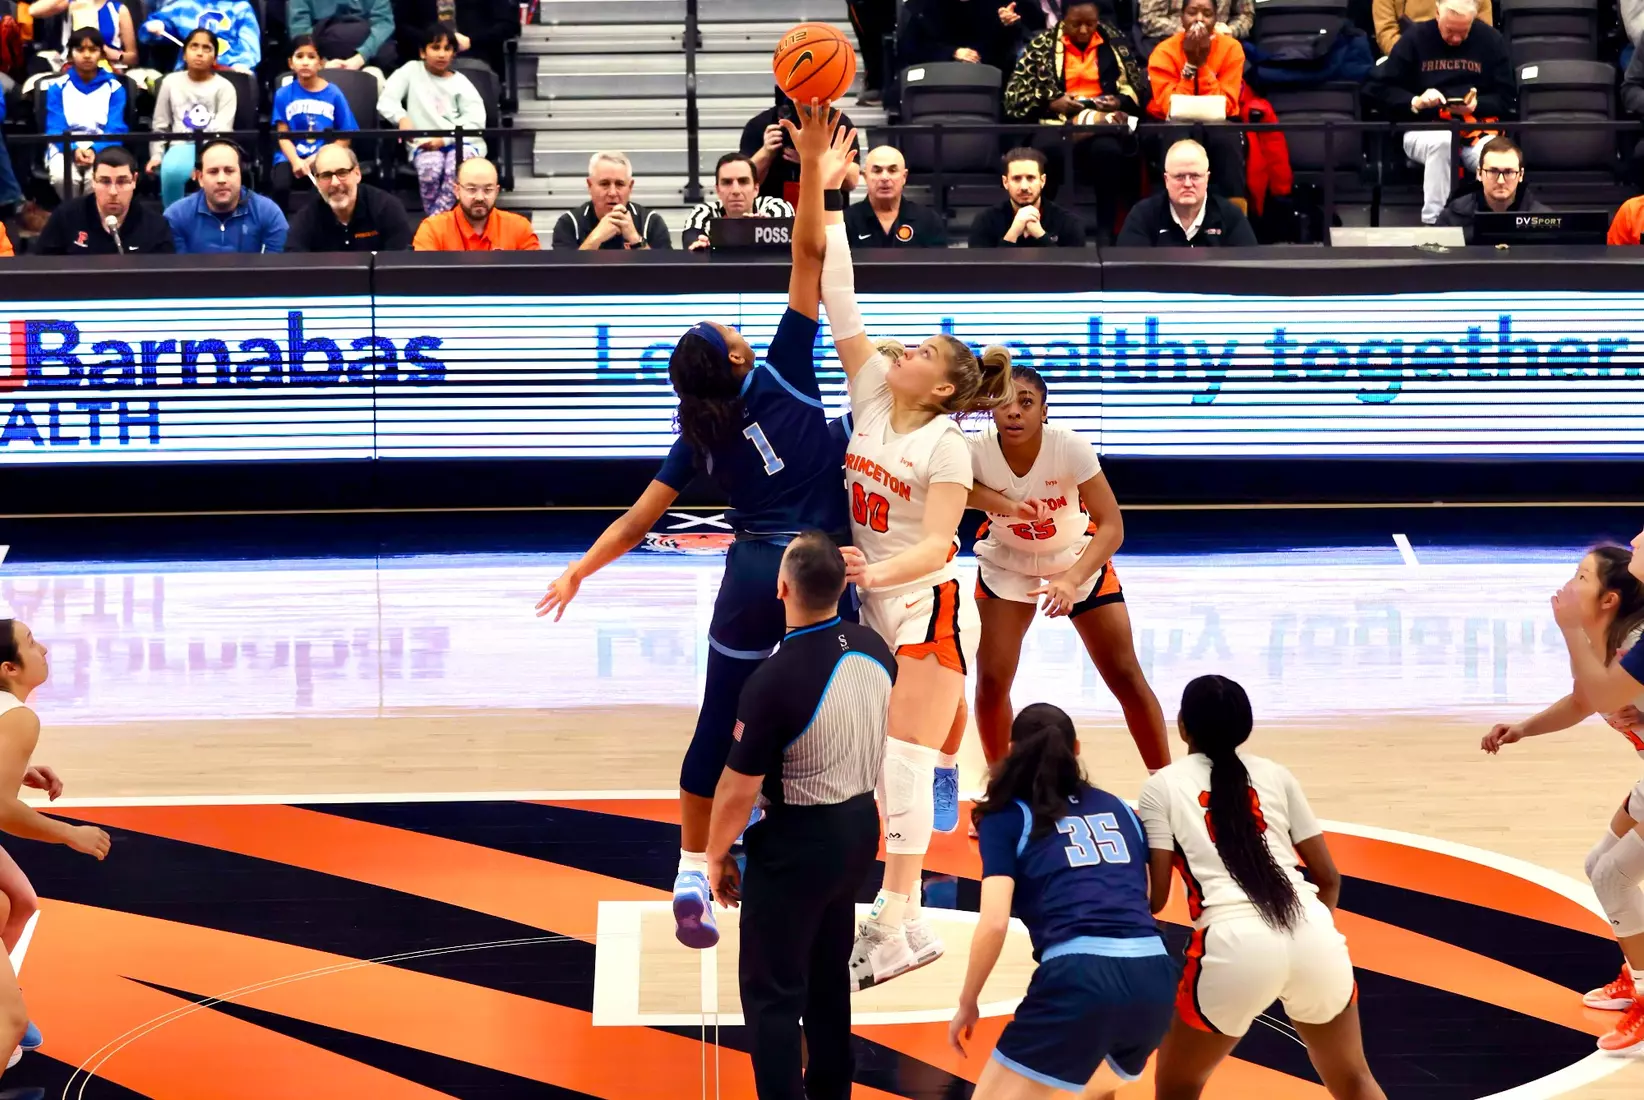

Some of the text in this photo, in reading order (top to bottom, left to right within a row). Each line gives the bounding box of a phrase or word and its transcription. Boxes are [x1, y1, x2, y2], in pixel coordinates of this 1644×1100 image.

[1421, 59, 1482, 74] PRINCETON
[755, 227, 792, 243] POSS.
[742, 422, 785, 476] 1
[852, 481, 890, 533] 00
[1055, 812, 1131, 868] 35
